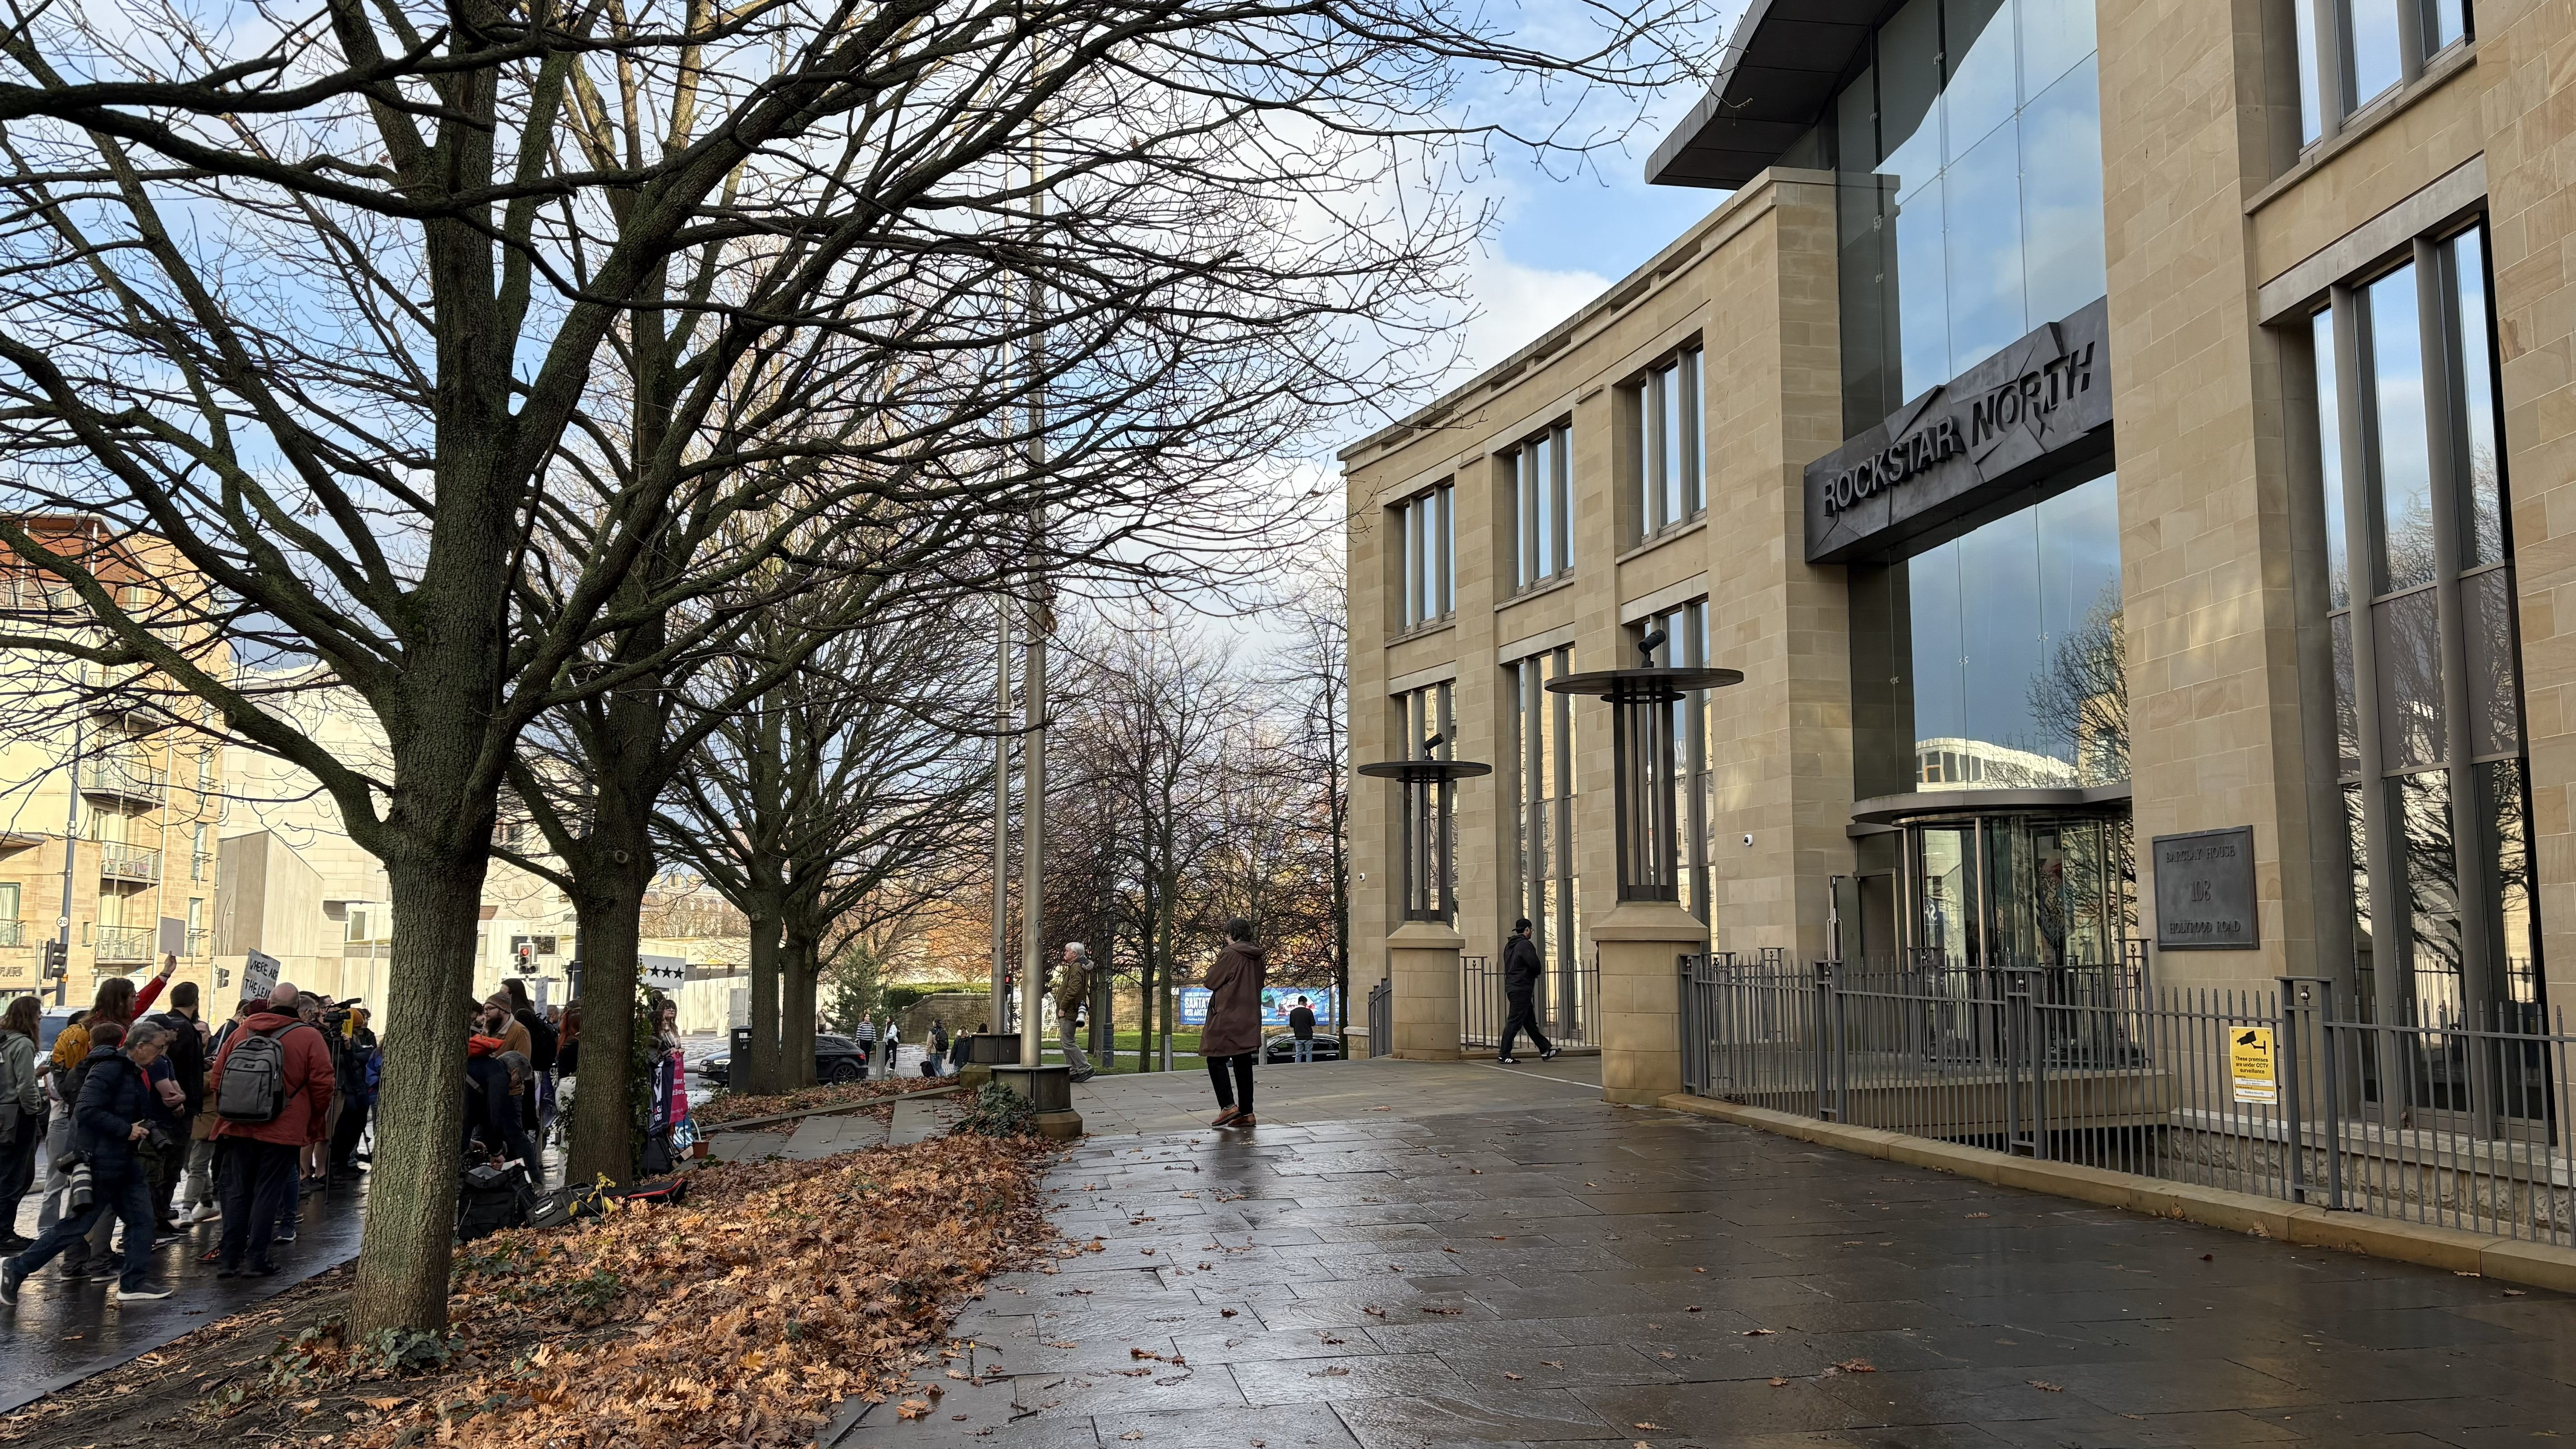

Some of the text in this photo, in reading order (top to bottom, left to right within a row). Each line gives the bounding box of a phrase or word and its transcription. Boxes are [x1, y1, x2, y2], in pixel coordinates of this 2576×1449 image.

[1823, 340, 2095, 517] ROCKSTAR NORTH
[2166, 845, 2235, 863] BARCLAY HOUSE
[2191, 879, 2211, 902] 108
[2170, 919, 2241, 934] HOLYROOD ROAD
[250, 958, 279, 980] WHERE ARE
[245, 978, 258, 994] THE
